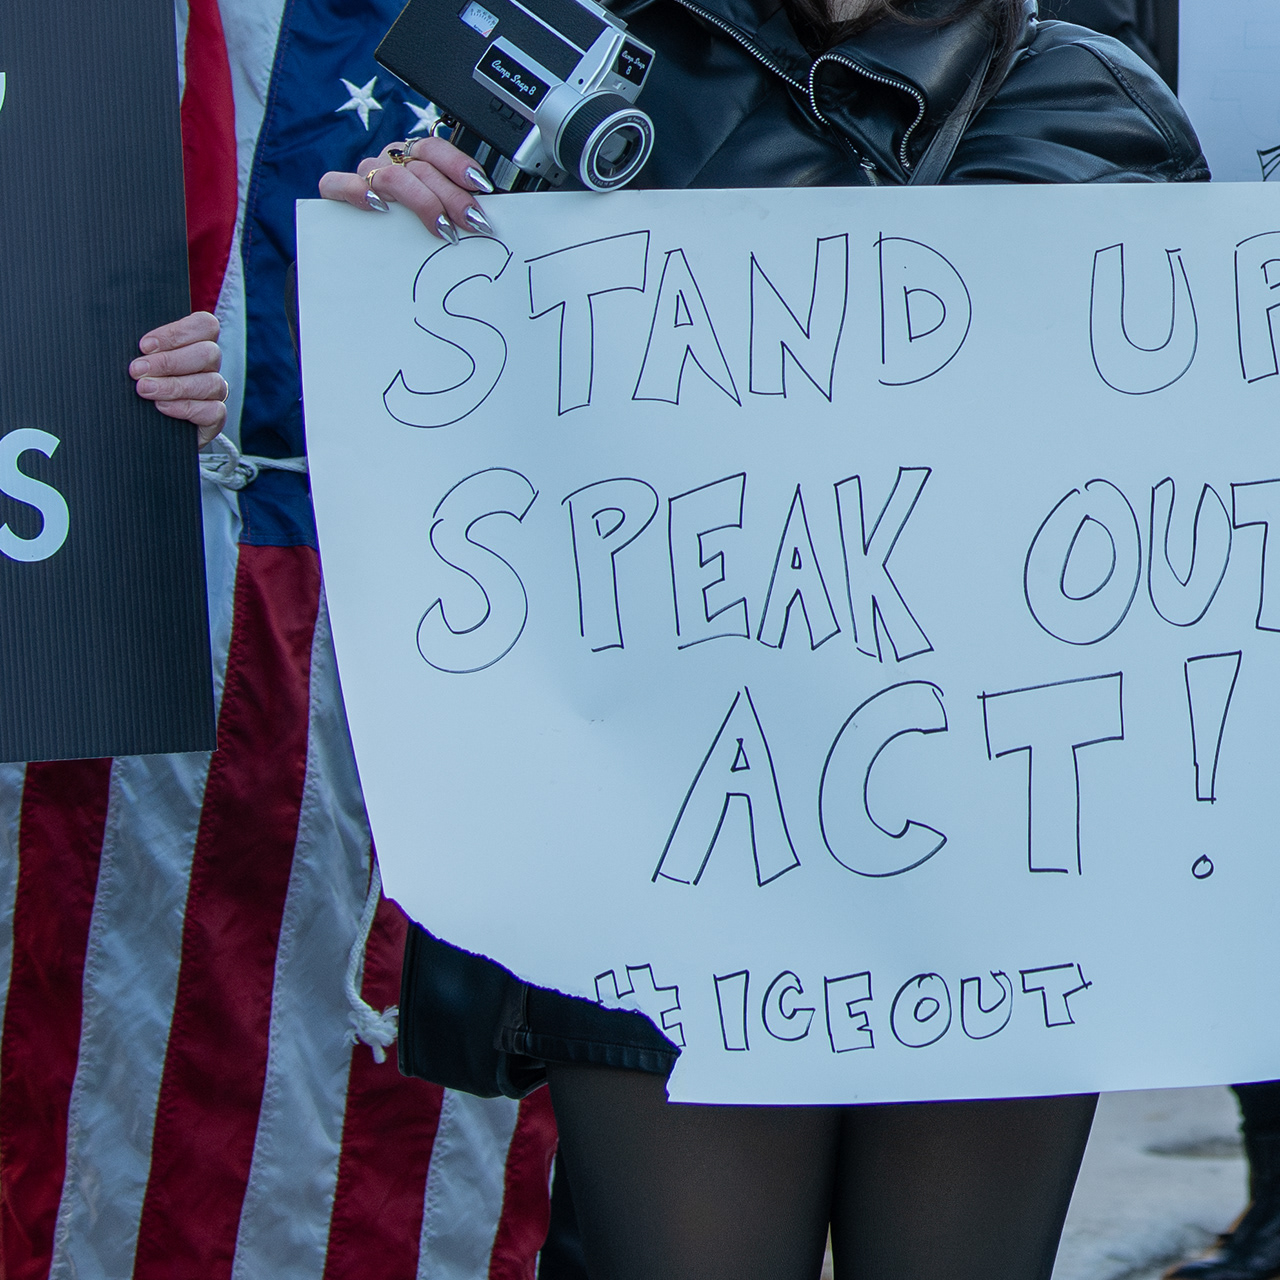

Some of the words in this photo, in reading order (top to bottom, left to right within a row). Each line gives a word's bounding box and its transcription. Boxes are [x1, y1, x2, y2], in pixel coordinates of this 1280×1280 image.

[382, 224, 972, 429] STAND
[416, 466, 935, 674] SPEAK
[651, 650, 1243, 888] ACT!
